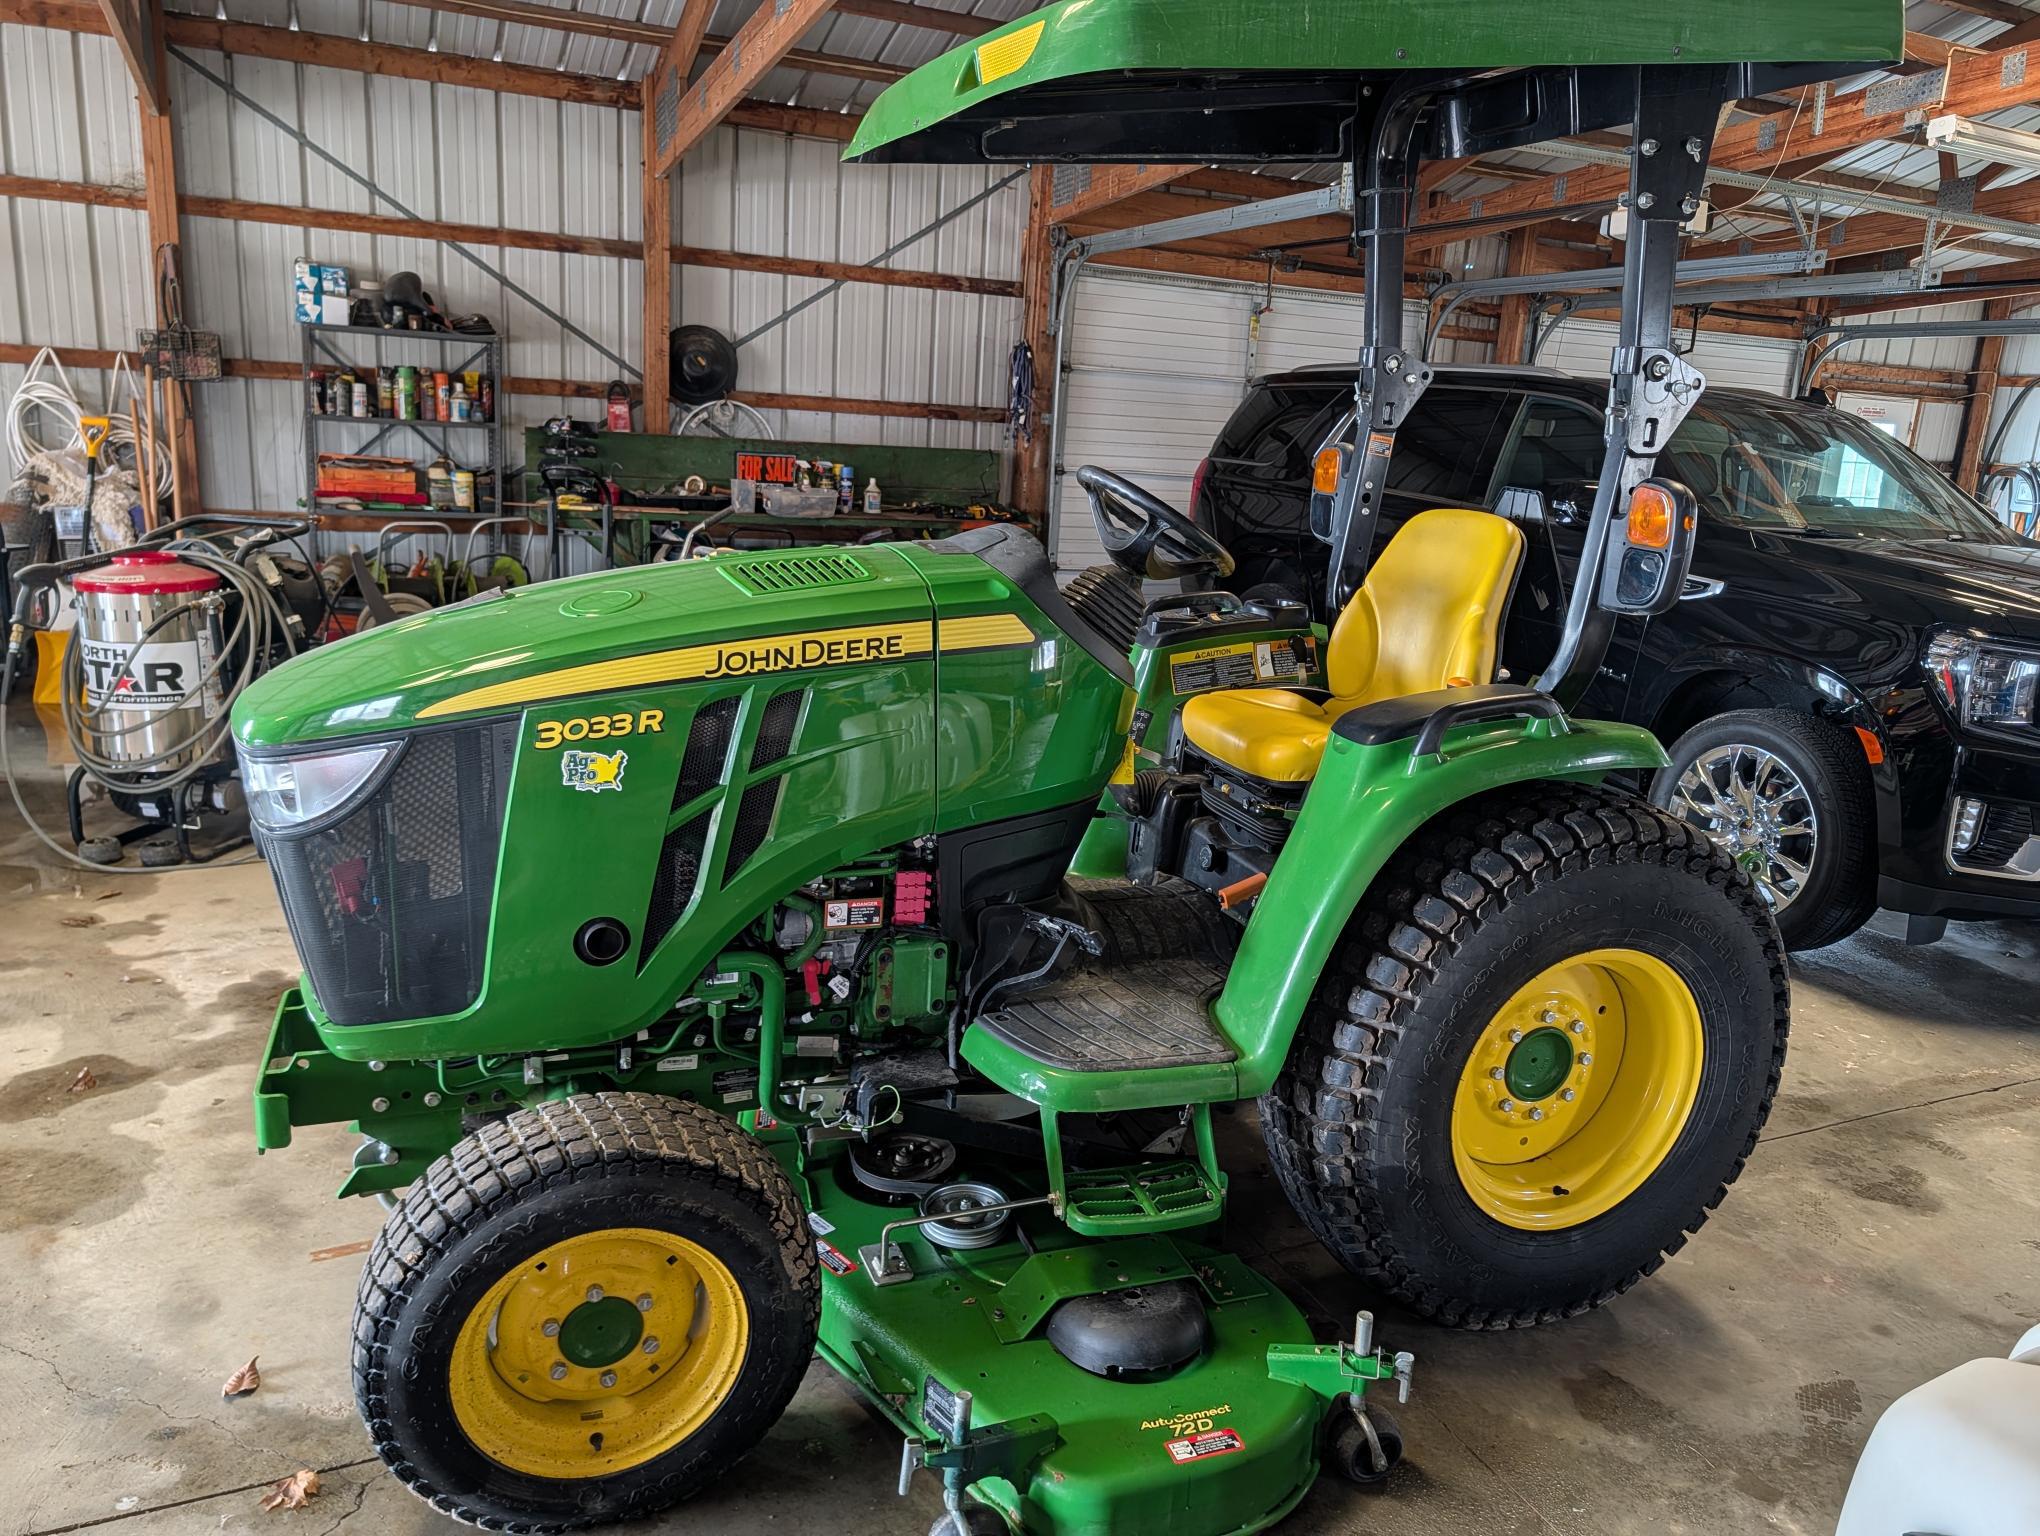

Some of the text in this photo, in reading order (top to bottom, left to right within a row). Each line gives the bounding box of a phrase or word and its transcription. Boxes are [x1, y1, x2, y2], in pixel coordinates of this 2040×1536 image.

[738, 455, 795, 482] FOR SALE
[83, 644, 127, 661] ORTH
[704, 635, 903, 675] JOHN DEERE
[1201, 648, 1232, 659] CAUTION
[101, 693, 182, 703] Prformance
[566, 753, 597, 770] Ag-
[566, 767, 597, 783] Pro
[401, 1211, 539, 1382] GALAXY
